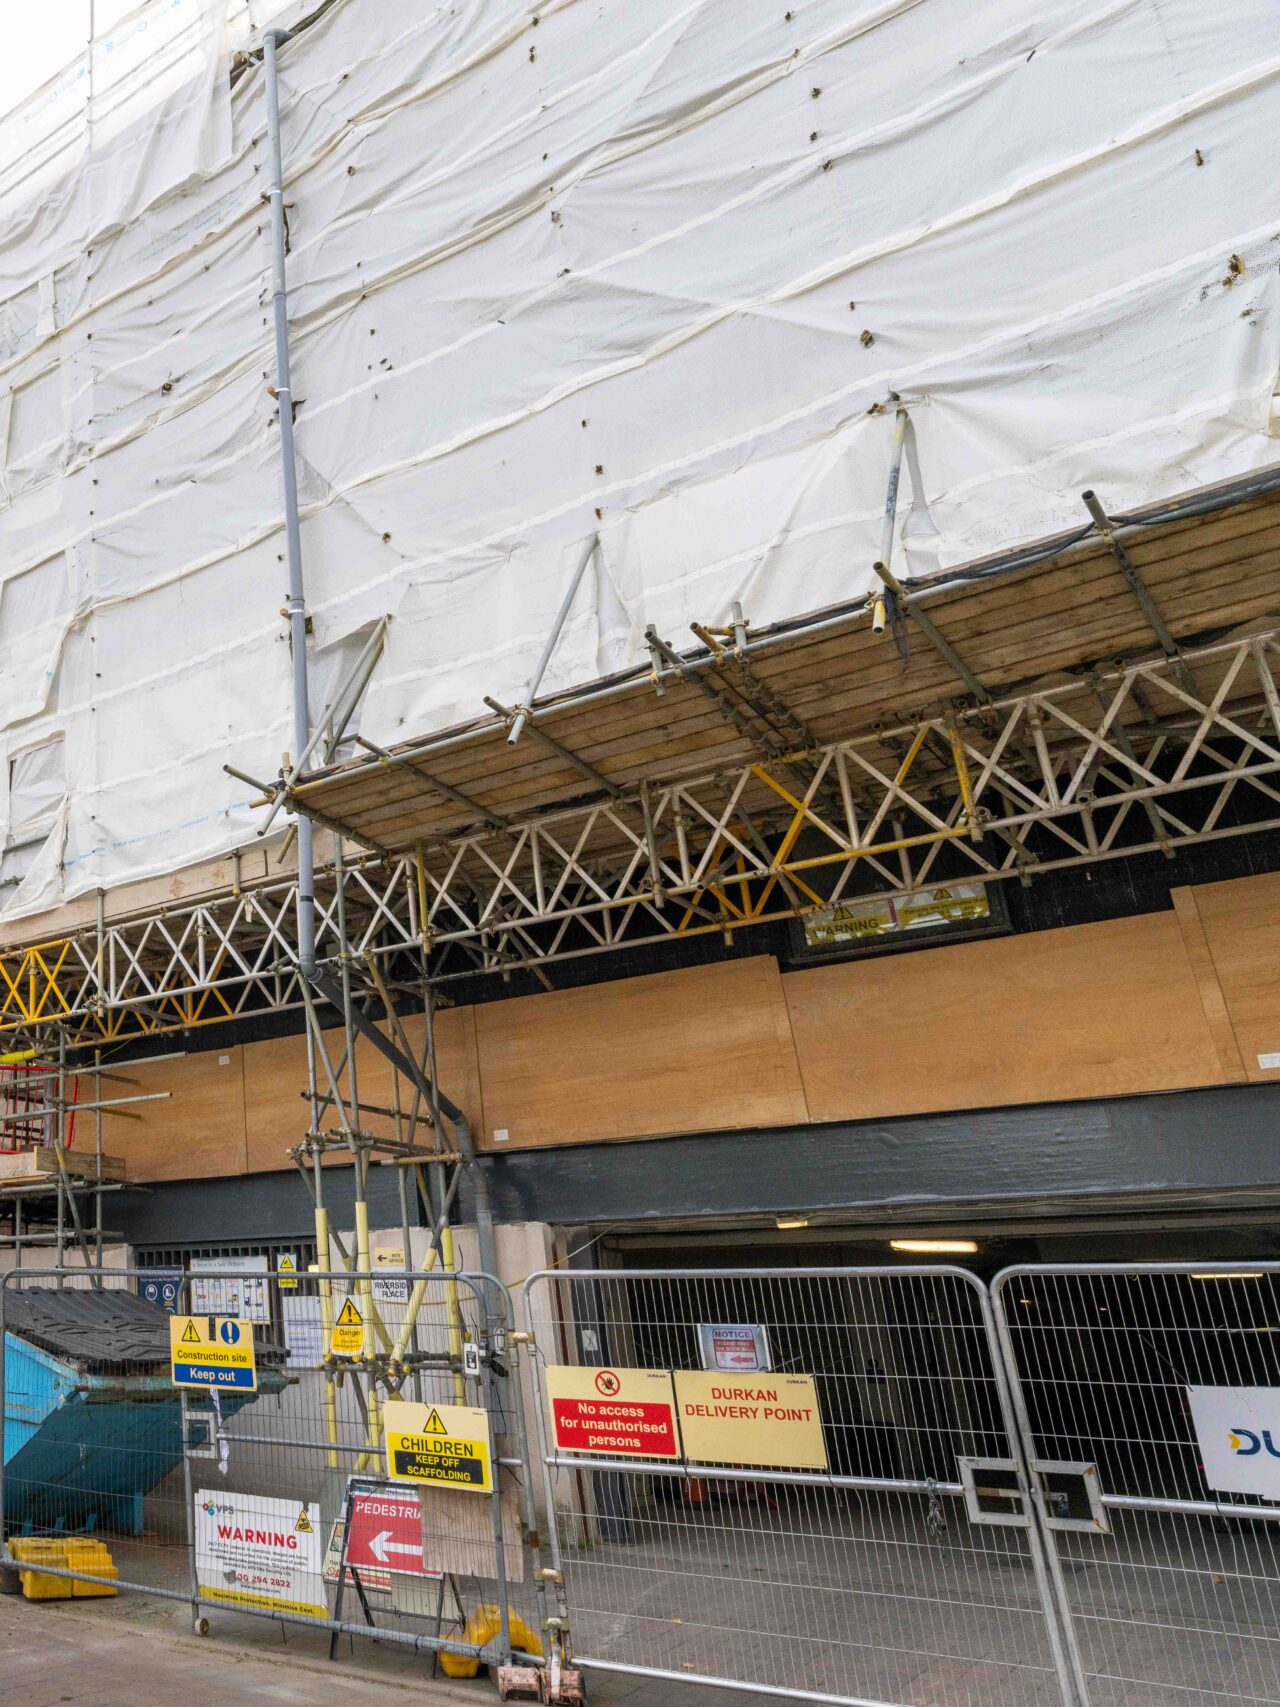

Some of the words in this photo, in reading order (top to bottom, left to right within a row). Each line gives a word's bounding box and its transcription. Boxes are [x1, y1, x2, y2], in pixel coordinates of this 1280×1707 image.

[382, 1290, 405, 1298] PLACE
[177, 1349, 229, 1362] Construction
[231, 1353, 247, 1363] site
[190, 1367, 215, 1382] Keep
[218, 1371, 236, 1381] out
[711, 1387, 779, 1402] DURKAN
[578, 1402, 596, 1414] No
[599, 1405, 645, 1417] access
[684, 1404, 759, 1419] DELIVERY
[763, 1407, 812, 1422] POINT
[560, 1416, 578, 1428] for
[581, 1418, 668, 1434] unauthorised
[400, 1436, 474, 1457] CHILDREN
[588, 1435, 641, 1447] persons
[415, 1454, 440, 1466] KEEP
[441, 1457, 460, 1468] OFF
[406, 1465, 471, 1482] SCAFFOLDING
[216, 1503, 235, 1515] VPS
[356, 1501, 421, 1520] PEDESTRI
[217, 1524, 298, 1550] WARNING
[252, 1575, 268, 1585] 294
[271, 1578, 291, 1588] 2822
[213, 1592, 239, 1601] Maximise
[240, 1596, 272, 1607] Protection.
[273, 1602, 298, 1612] Minimise
